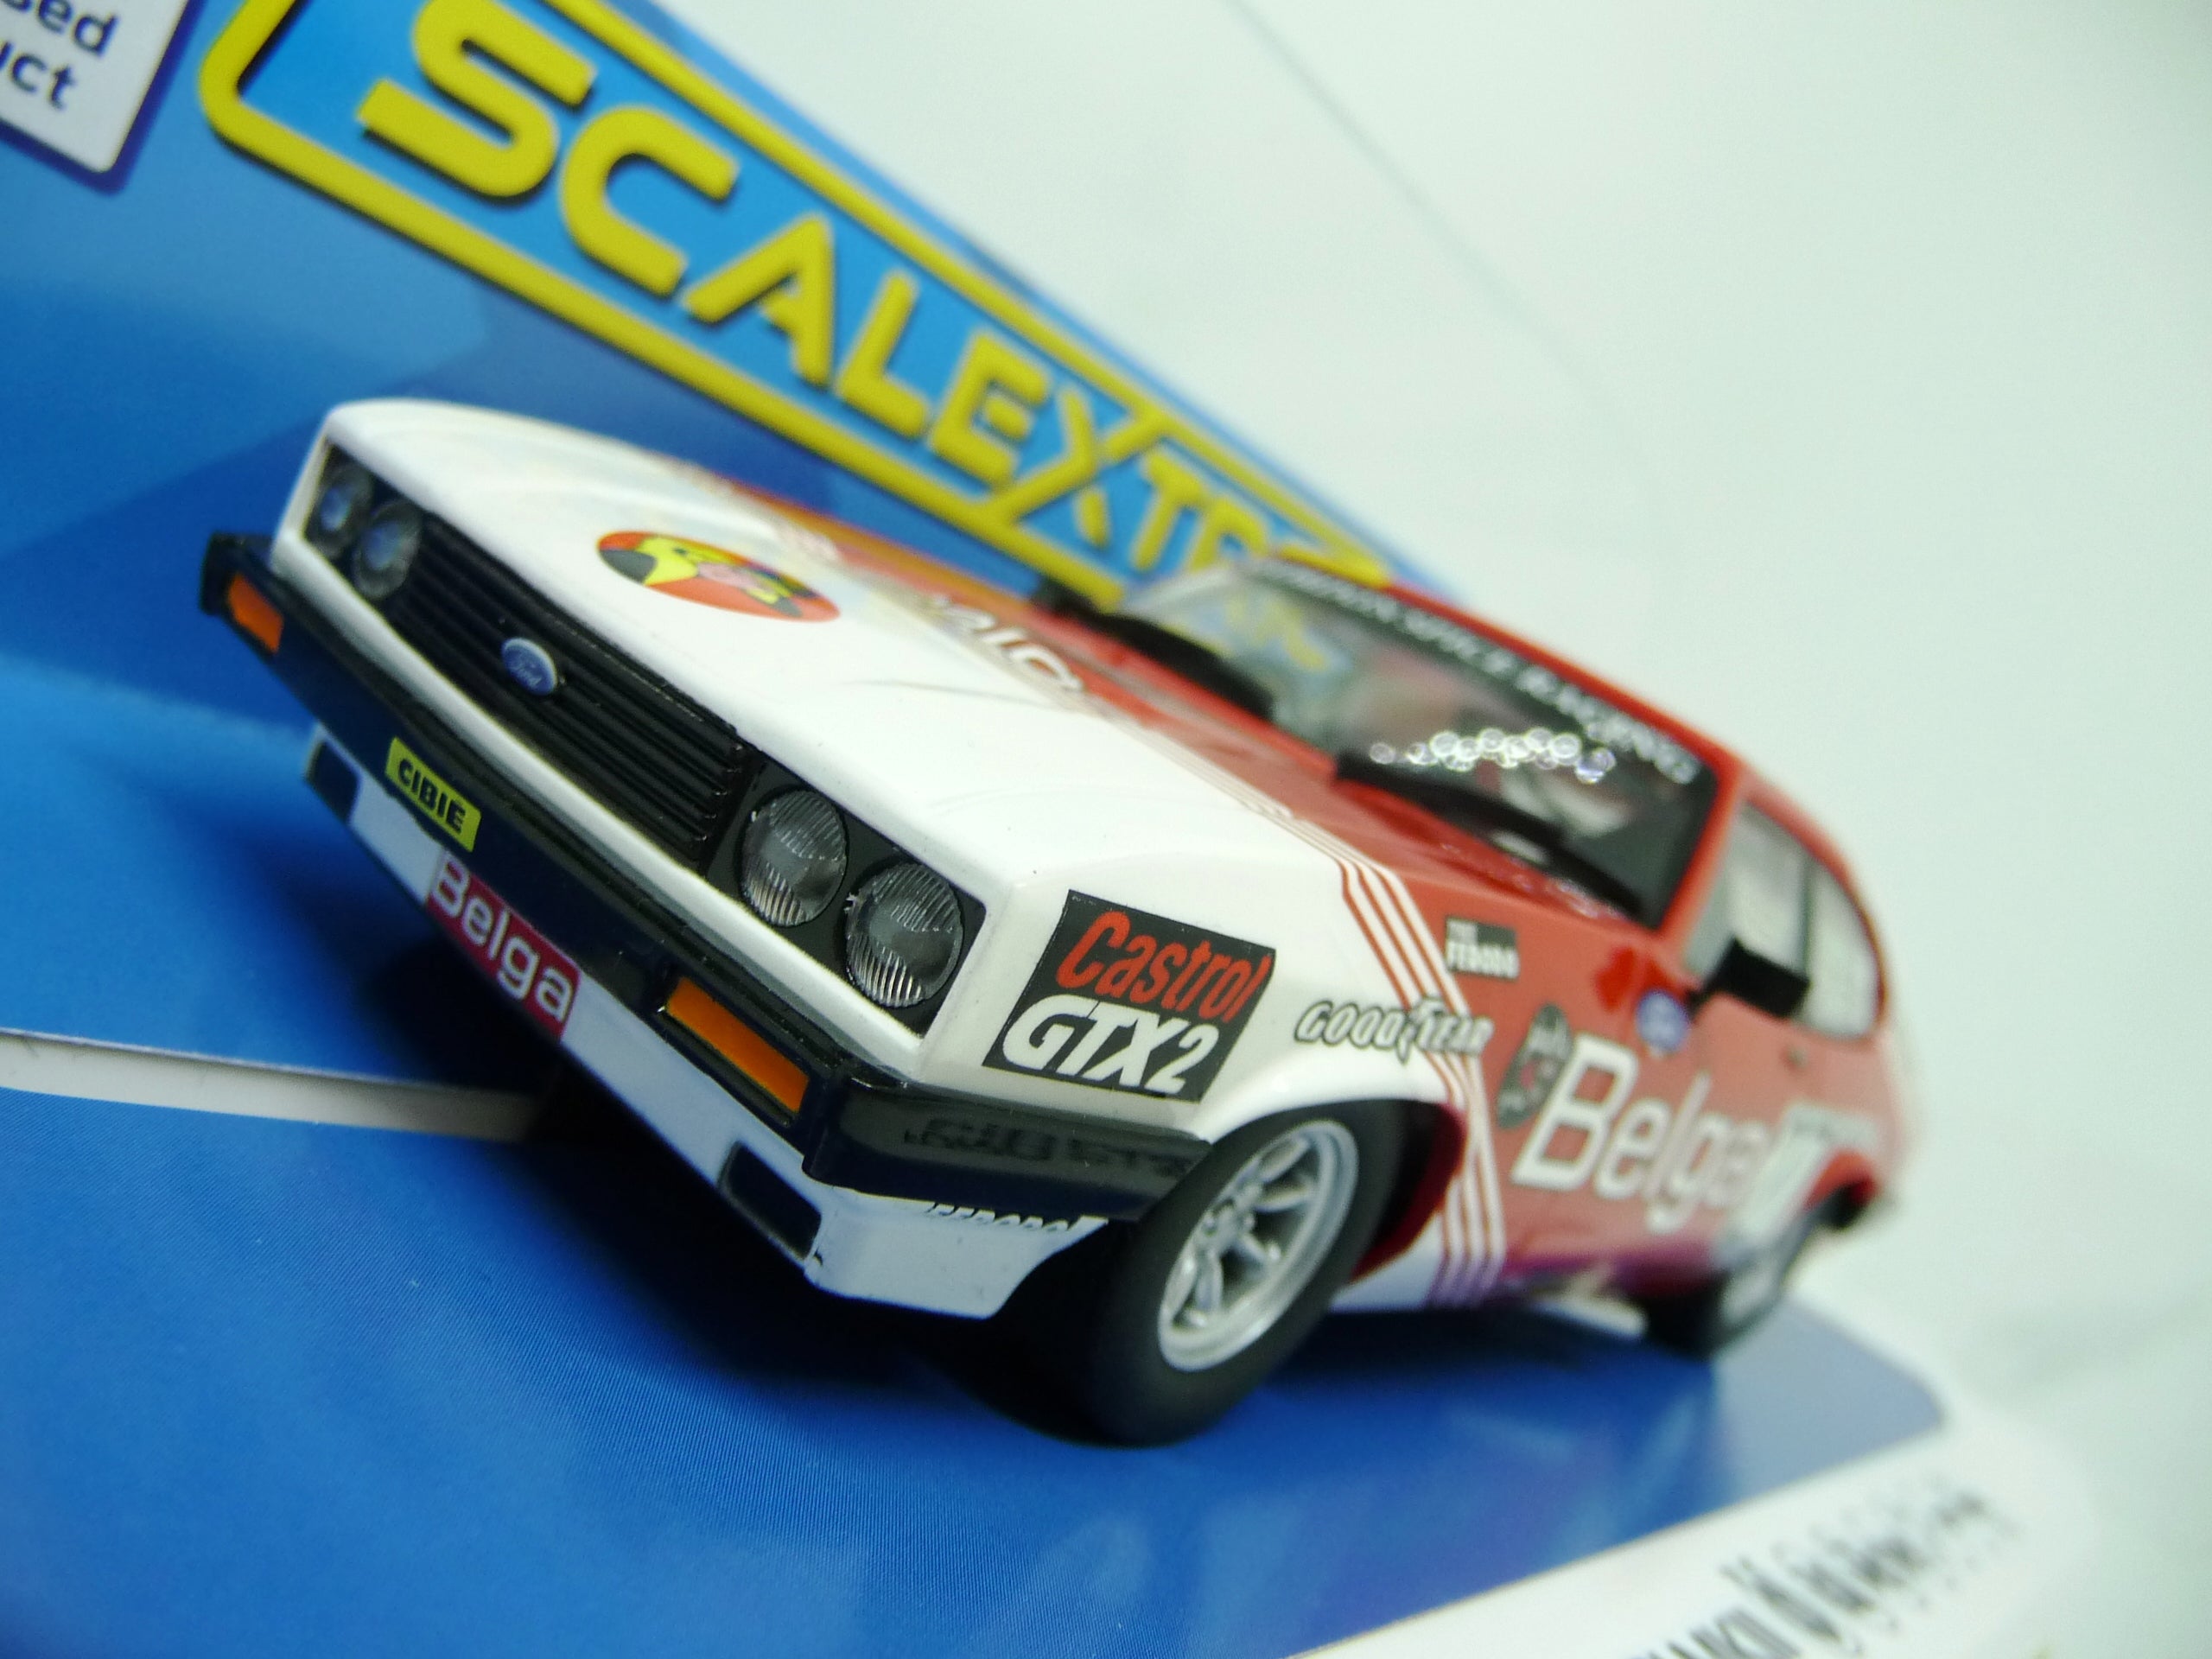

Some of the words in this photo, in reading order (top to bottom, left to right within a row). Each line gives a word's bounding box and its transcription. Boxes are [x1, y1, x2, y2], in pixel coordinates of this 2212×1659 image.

[431, 849, 574, 1023] Belga
[1056, 910, 1273, 1023] Castrol
[1002, 994, 1219, 1095] GTX2
[1511, 1032, 1768, 1234] Belga
